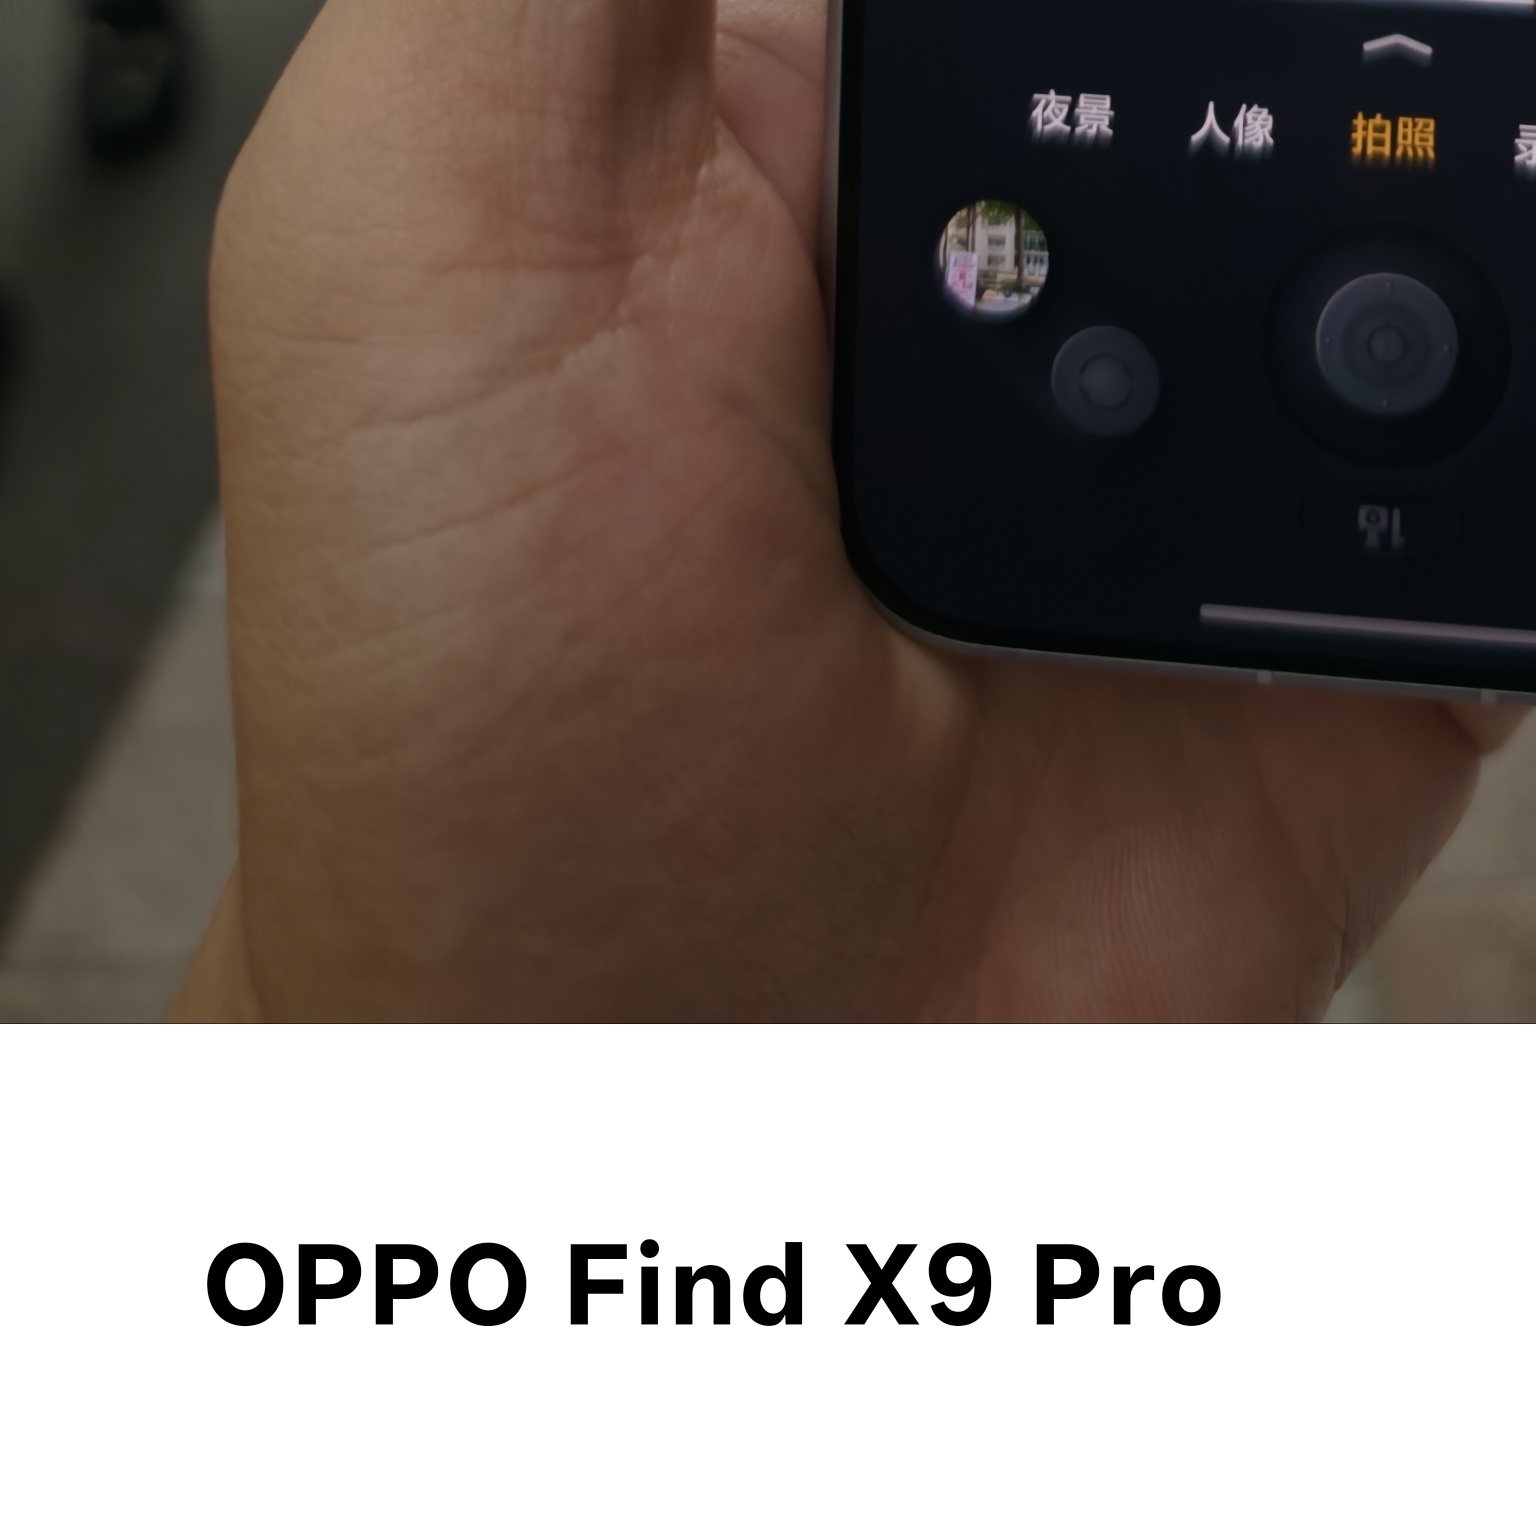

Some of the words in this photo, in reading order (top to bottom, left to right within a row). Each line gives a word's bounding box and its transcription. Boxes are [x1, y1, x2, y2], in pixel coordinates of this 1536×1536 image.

[1031, 88, 1115, 135] 夜景
[1190, 100, 1275, 148] 人像
[1351, 111, 1436, 158] 拍照
